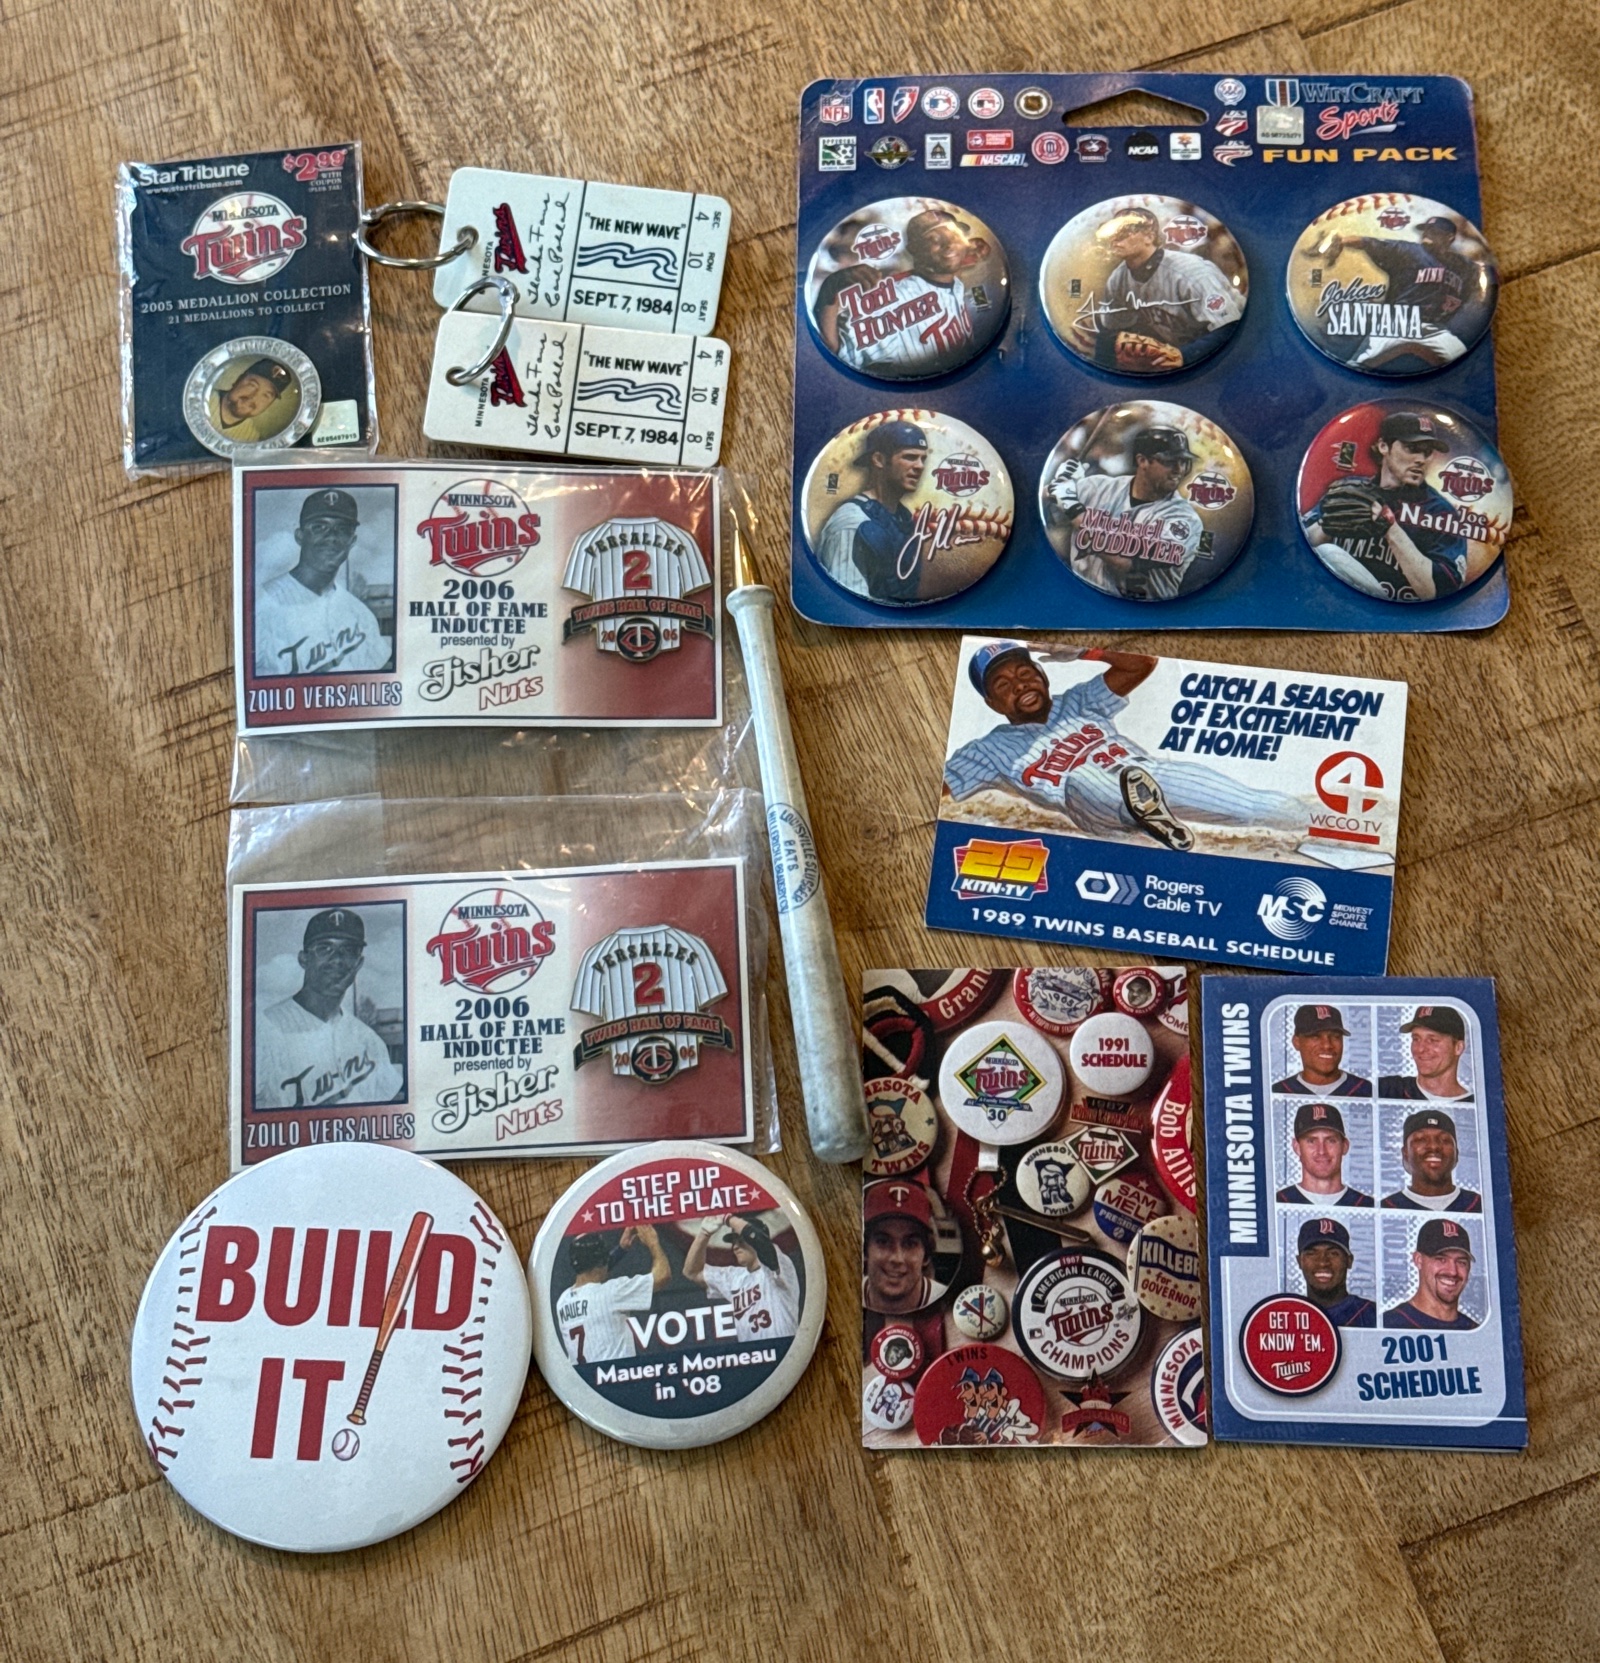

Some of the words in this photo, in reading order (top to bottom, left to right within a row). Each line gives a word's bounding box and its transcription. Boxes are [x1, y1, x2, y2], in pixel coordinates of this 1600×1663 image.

[1316, 102, 1399, 140] Sports
[980, 154, 1025, 166] NASCAR
[1128, 145, 1159, 156] NCAA
[1263, 149, 1338, 163] FUN
[1354, 147, 1457, 162] PACK
[179, 163, 249, 182] Tribune
[310, 178, 342, 186] COUPON
[695, 211, 710, 222] 4
[615, 220, 644, 236] NEW
[646, 223, 687, 240] WAVE"
[182, 216, 306, 279] Twins
[706, 252, 716, 272] ROW
[141, 302, 173, 314] 2005
[179, 292, 259, 311] MEDALLION
[264, 284, 351, 302] COLLECTION
[573, 290, 617, 309] SEPT.
[636, 298, 673, 315] 1984
[681, 302, 696, 313] 8
[1315, 277, 1386, 318] Johan
[168, 315, 181, 325] 21
[185, 308, 254, 323] MEDALLIONS
[258, 306, 273, 316] TO
[276, 302, 325, 315] COLLECT
[851, 291, 942, 351] HUNTER
[1327, 303, 1422, 339] SANTANA
[615, 357, 644, 372] NEW
[648, 360, 688, 376] WAVE"
[697, 350, 712, 360] 4
[710, 387, 720, 406] ROW
[574, 421, 621, 440] SEPT.
[640, 429, 679, 445] 1984
[687, 433, 703, 444] 8
[705, 431, 715, 452] SEAT
[448, 494, 517, 509] MINNESOTA
[1080, 507, 1165, 542] Michael
[1399, 502, 1488, 542] Nathan
[1457, 505, 1487, 526] Joe
[416, 511, 541, 567] Twins
[584, 532, 687, 558] VERSALLES
[1076, 528, 1186, 565] CUDDYER
[623, 550, 652, 590] 2
[443, 579, 515, 601] 2006
[409, 602, 460, 617] HALL
[466, 602, 492, 617] OF
[497, 602, 548, 618] FAME
[617, 600, 648, 614] HALL
[650, 600, 666, 612] OF
[431, 618, 526, 634] INDUCTEE
[440, 634, 498, 649] presented
[501, 634, 516, 649] by
[418, 644, 541, 703] Fisher
[248, 686, 296, 713] ZOILO
[303, 681, 403, 710] VERSALLES
[479, 676, 543, 711] Nuts
[1180, 673, 1257, 703] CATCH
[1255, 681, 1277, 706] A
[1280, 683, 1385, 717] SEASON
[1171, 699, 1206, 725] OF
[1206, 702, 1361, 742] EXCITEMENT
[1022, 723, 1106, 787] Twins
[1092, 743, 1130, 769] 34
[1158, 726, 1195, 752] AT
[1194, 729, 1284, 761] HOME!
[1309, 813, 1359, 831] WCCO
[1365, 820, 1383, 833] TV
[1145, 875, 1205, 896] Rogers
[458, 904, 530, 920] MINNESOTA
[1143, 894, 1191, 913] Cable
[1195, 900, 1223, 917] TV
[1256, 894, 1326, 924] MSC
[1331, 911, 1366, 922] SPORTS
[1333, 903, 1374, 916] MIDWEST
[971, 907, 1026, 927] 1989
[1033, 915, 1105, 937] TWINS
[1112, 926, 1218, 951] BASEBALL
[1226, 941, 1336, 967] SCHEDULE
[1329, 918, 1369, 931] CHANNEL
[426, 921, 556, 986] Twins
[592, 942, 699, 975] VERSALLES
[633, 961, 666, 1008] 2
[455, 996, 530, 1021] 2006
[420, 1023, 473, 1042] HALL
[480, 1021, 507, 1038] OF
[512, 1018, 566, 1036] FAME
[585, 1021, 628, 1047] TWINS
[629, 1017, 662, 1033] HALL
[664, 1015, 682, 1028] OF
[684, 1018, 721, 1032] FAME
[443, 1037, 543, 1059] INDUCTEE
[1098, 1038, 1130, 1051] 1991
[1221, 1003, 1251, 1088] TWINS
[453, 1057, 514, 1075] presented
[517, 1057, 532, 1073] by
[1081, 1053, 1147, 1068] SCHEDULE
[969, 1066, 1031, 1093] Twins
[432, 1064, 559, 1134] Fisher
[496, 1099, 563, 1141] Nuts
[987, 1108, 1007, 1122] 30
[1160, 1099, 1186, 1138] Bob
[247, 1121, 300, 1148] ZOILO
[309, 1113, 415, 1143] VERSALLES
[871, 1141, 930, 1174] TWINS
[1225, 1093, 1258, 1244] MINNESOTA
[622, 1171, 681, 1199] STEP
[689, 1166, 720, 1188] UP
[595, 1200, 624, 1224] TO
[629, 1194, 675, 1220] THE
[679, 1184, 750, 1213] PLATE
[1043, 1204, 1076, 1214] TWINS
[1118, 1184, 1157, 1210] SAM
[195, 1225, 477, 1331] BUILD
[1034, 1267, 1079, 1301] AMERICAN
[1081, 1267, 1118, 1293] LEAGUE
[1155, 1272, 1172, 1284] for
[1060, 1293, 1099, 1306] MINNESOTA
[1141, 1279, 1197, 1310] GOVERNOR
[560, 1299, 588, 1324] MAUER
[1045, 1303, 1114, 1343] Twins
[1269, 1311, 1289, 1330] GET
[1294, 1311, 1309, 1330] TO
[627, 1303, 737, 1349] VOTE
[569, 1325, 586, 1365] 7
[1040, 1329, 1130, 1371] CHAMPIONS
[1259, 1333, 1295, 1351] KNOW
[1301, 1334, 1326, 1353] 'EM.
[1381, 1334, 1448, 1364] 2001
[597, 1362, 663, 1386] Mauer
[667, 1362, 678, 1376] &
[682, 1348, 776, 1374] Morneau
[945, 1347, 988, 1367] TWINS
[1160, 1338, 1202, 1429] MINNESOTA
[1271, 1360, 1311, 1381] Twins
[655, 1381, 675, 1401] in
[682, 1375, 722, 1397] '08
[1357, 1366, 1483, 1402] SCHEDULE
